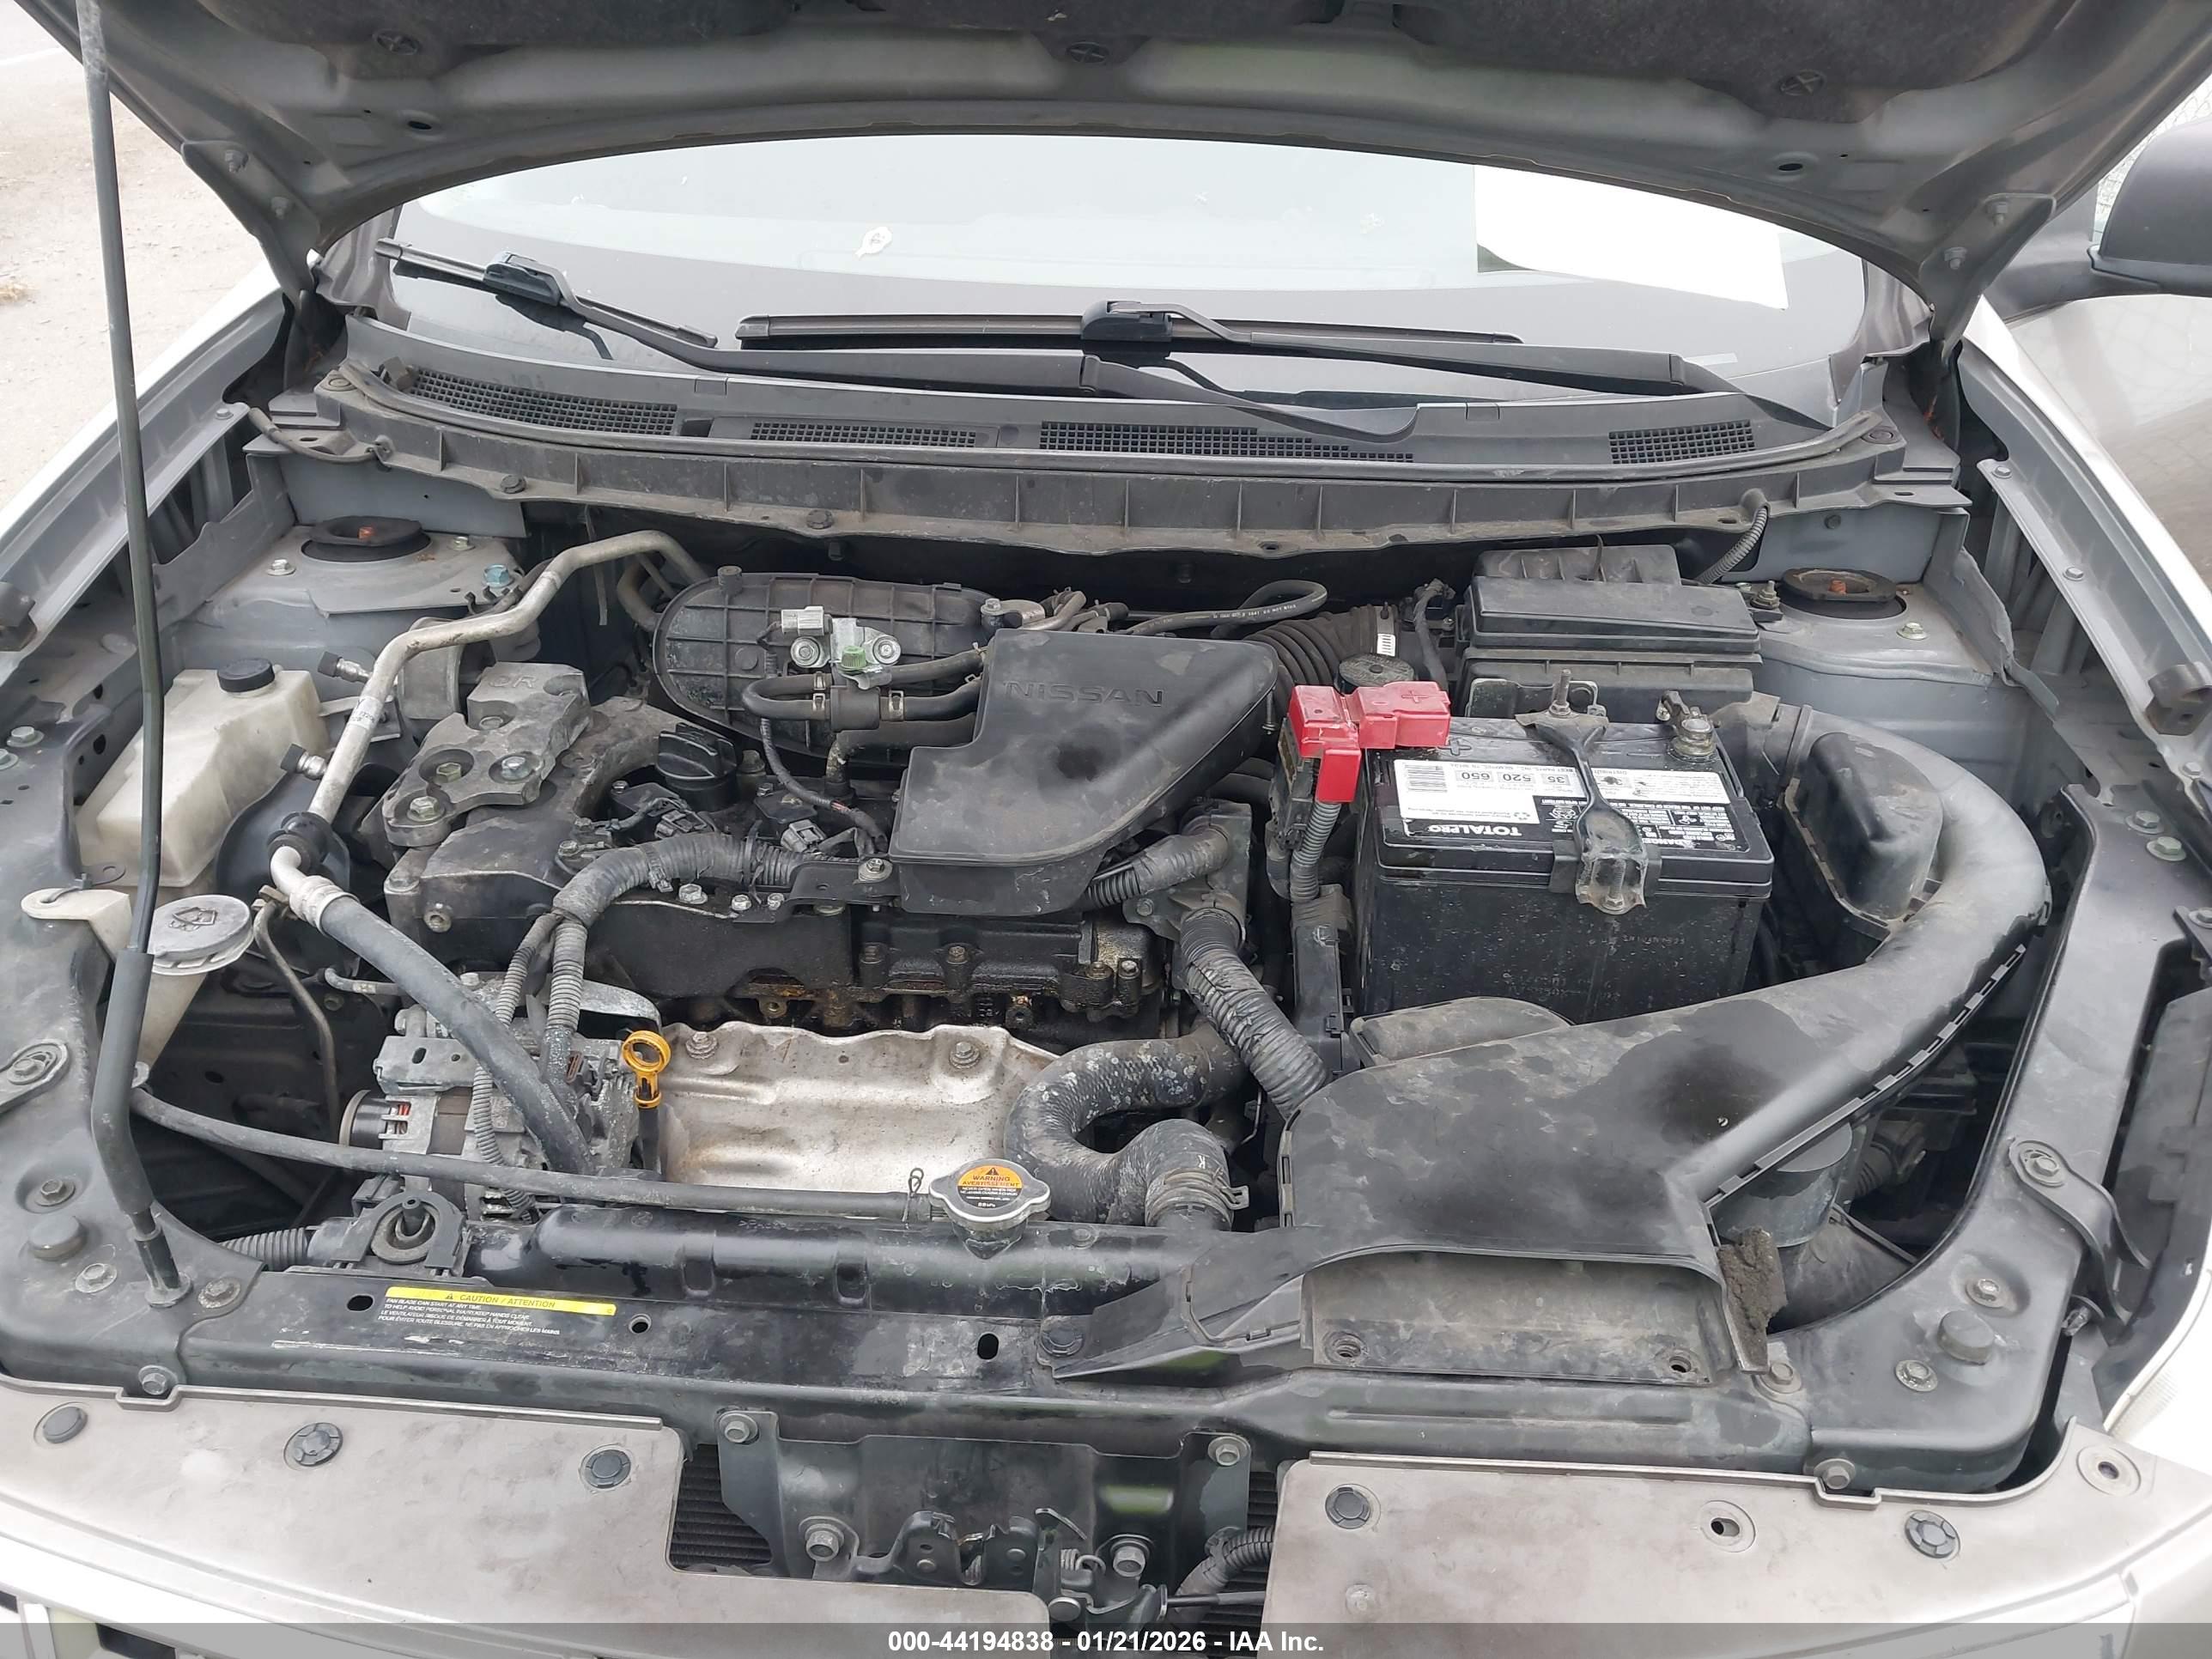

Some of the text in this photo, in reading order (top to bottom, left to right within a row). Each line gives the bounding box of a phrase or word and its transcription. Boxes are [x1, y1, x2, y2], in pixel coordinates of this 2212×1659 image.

[1003, 681, 1164, 707] NISSAN
[1462, 772, 1490, 781] 650
[1503, 774, 1531, 782] 520
[1427, 824, 1522, 836] TOTALPRO
[460, 1294, 499, 1303] CAUTION
[507, 1298, 556, 1308] ATTENTION
